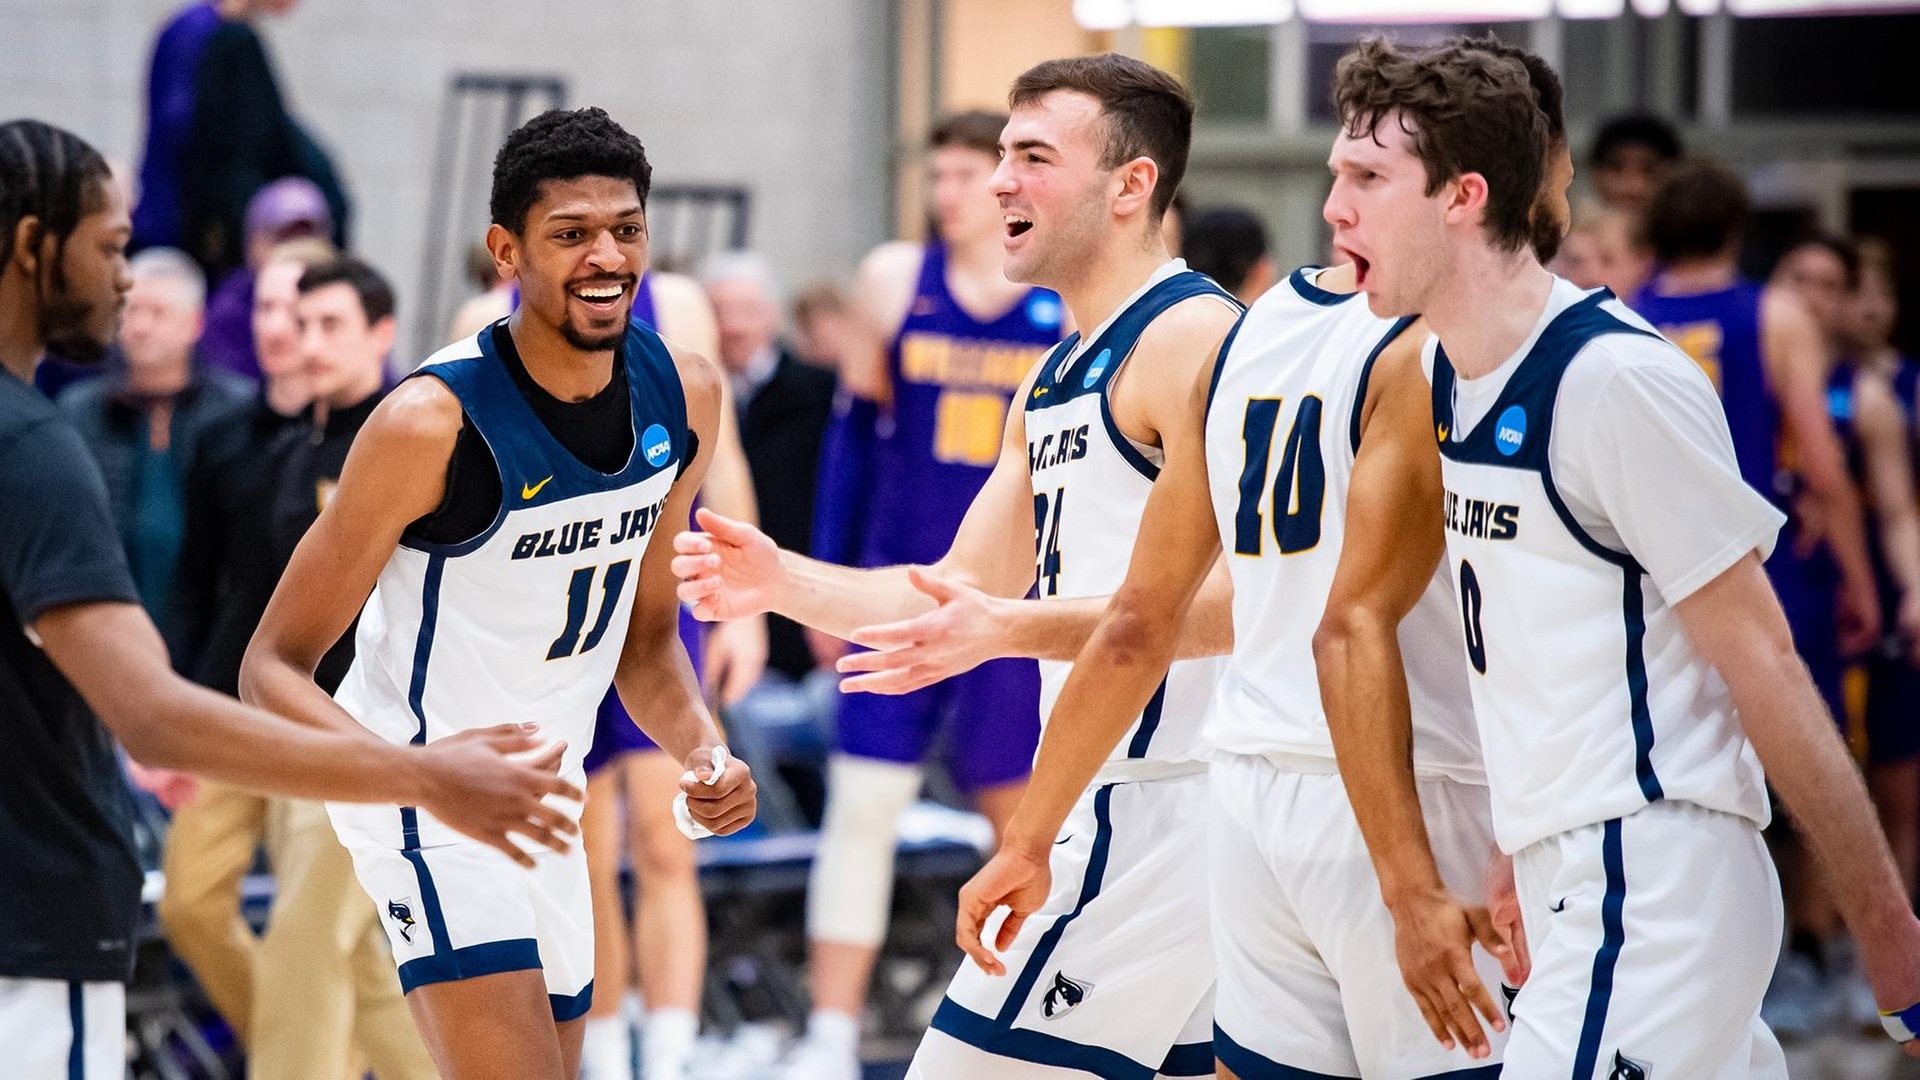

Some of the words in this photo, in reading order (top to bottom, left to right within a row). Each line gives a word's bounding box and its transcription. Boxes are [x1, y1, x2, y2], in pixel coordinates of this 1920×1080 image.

[647, 440, 671, 460] NCAA
[1234, 393, 1326, 558] 10
[511, 518, 604, 561] BLUE
[609, 497, 668, 545] JAY
[1460, 498, 1521, 541] JAYS
[545, 558, 632, 662] 11
[1459, 558, 1487, 676] 0
